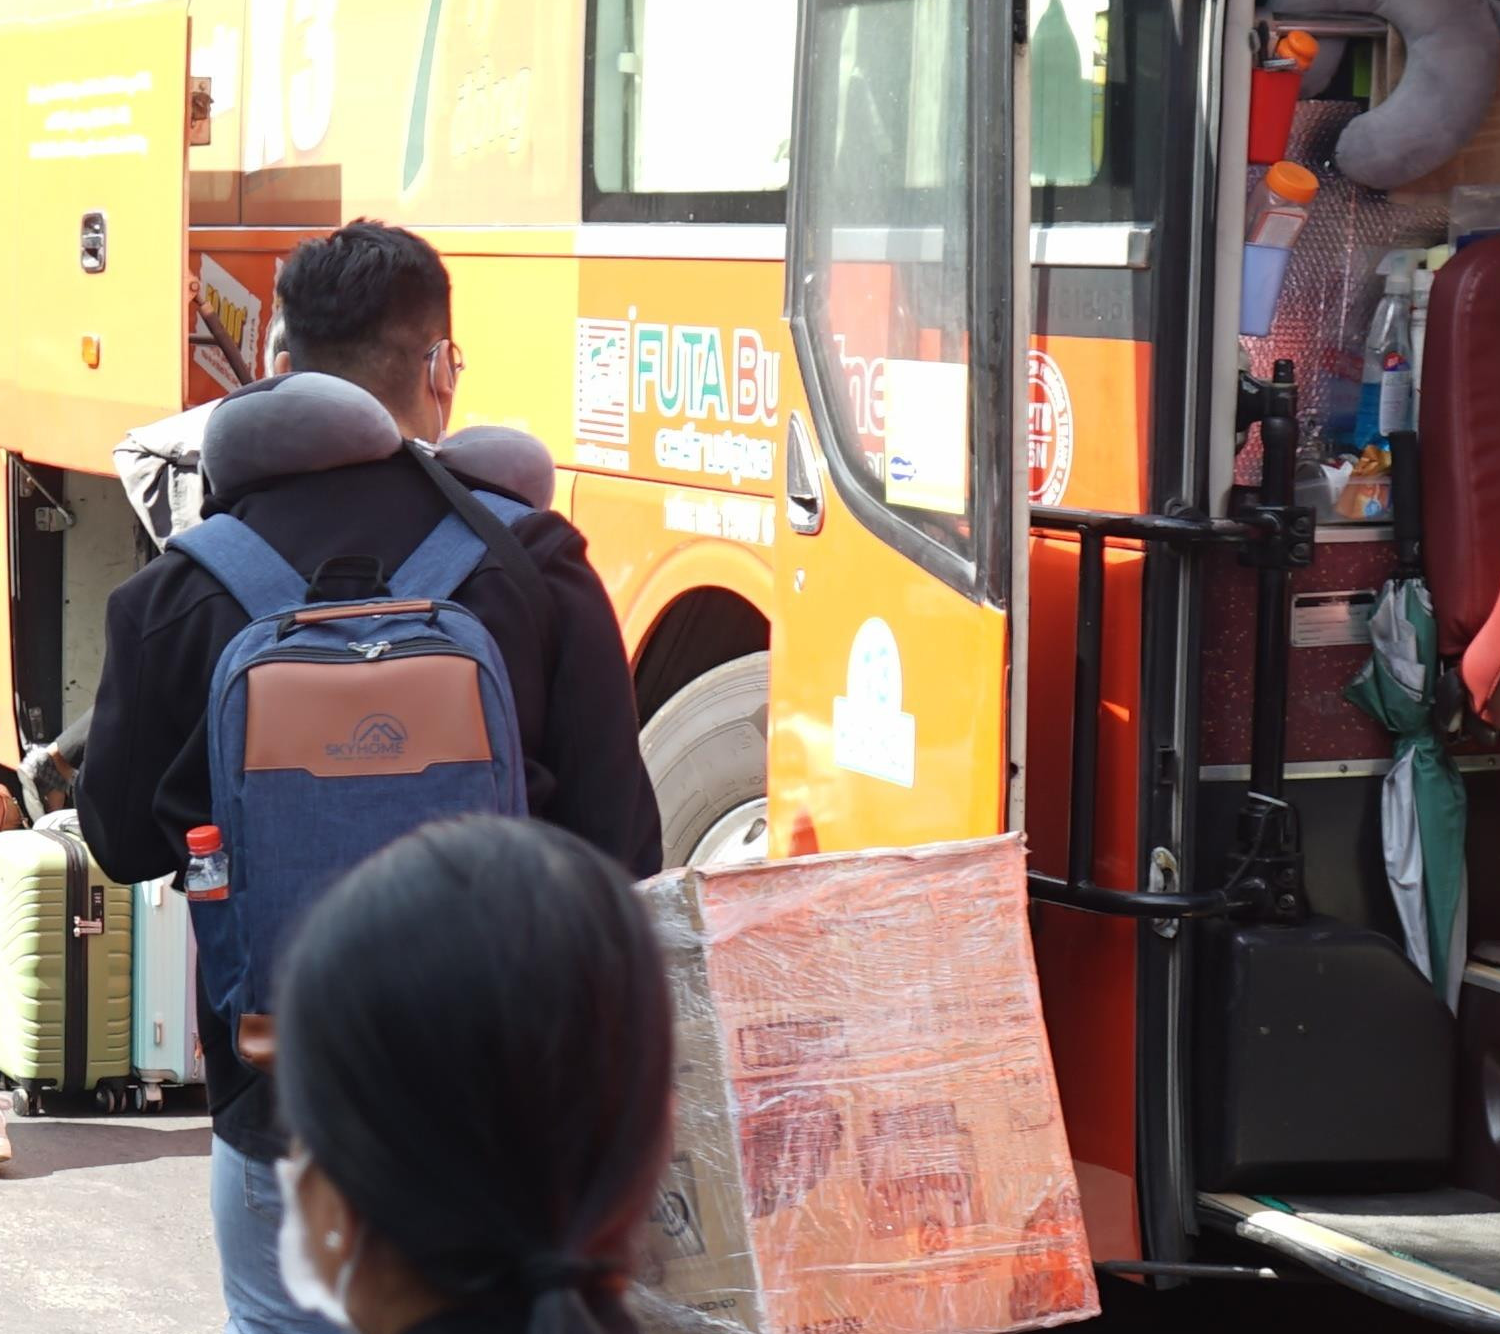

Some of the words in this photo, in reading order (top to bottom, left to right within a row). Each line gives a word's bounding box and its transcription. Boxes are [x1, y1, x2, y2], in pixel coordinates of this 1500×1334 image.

[633, 322, 730, 422] FUTA
[733, 327, 781, 427] Bu
[324, 742, 406, 756] SKYHOME
